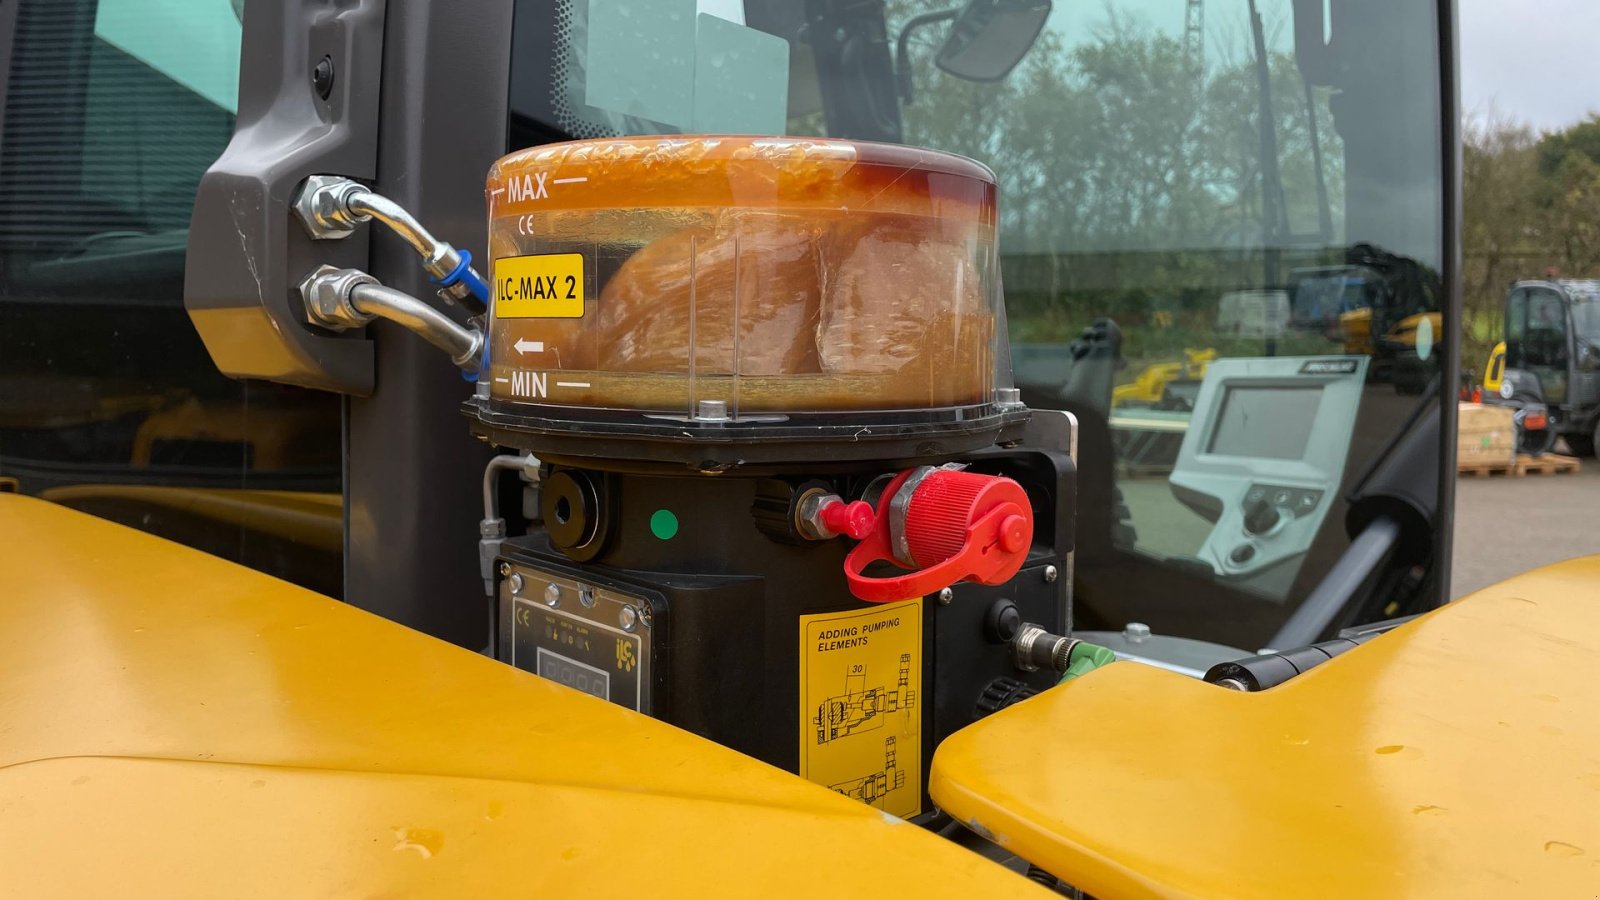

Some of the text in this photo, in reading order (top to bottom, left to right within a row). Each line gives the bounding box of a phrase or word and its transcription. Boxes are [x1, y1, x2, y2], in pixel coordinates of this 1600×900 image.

[508, 171, 549, 204] MAX
[518, 214, 534, 236] CE
[497, 275, 576, 302] ILC-MAX 2
[511, 371, 547, 398] MIN
[818, 617, 900, 640] ADDING PUMPING
[818, 637, 868, 651] ELEMENTS
[852, 664, 863, 674] 30
